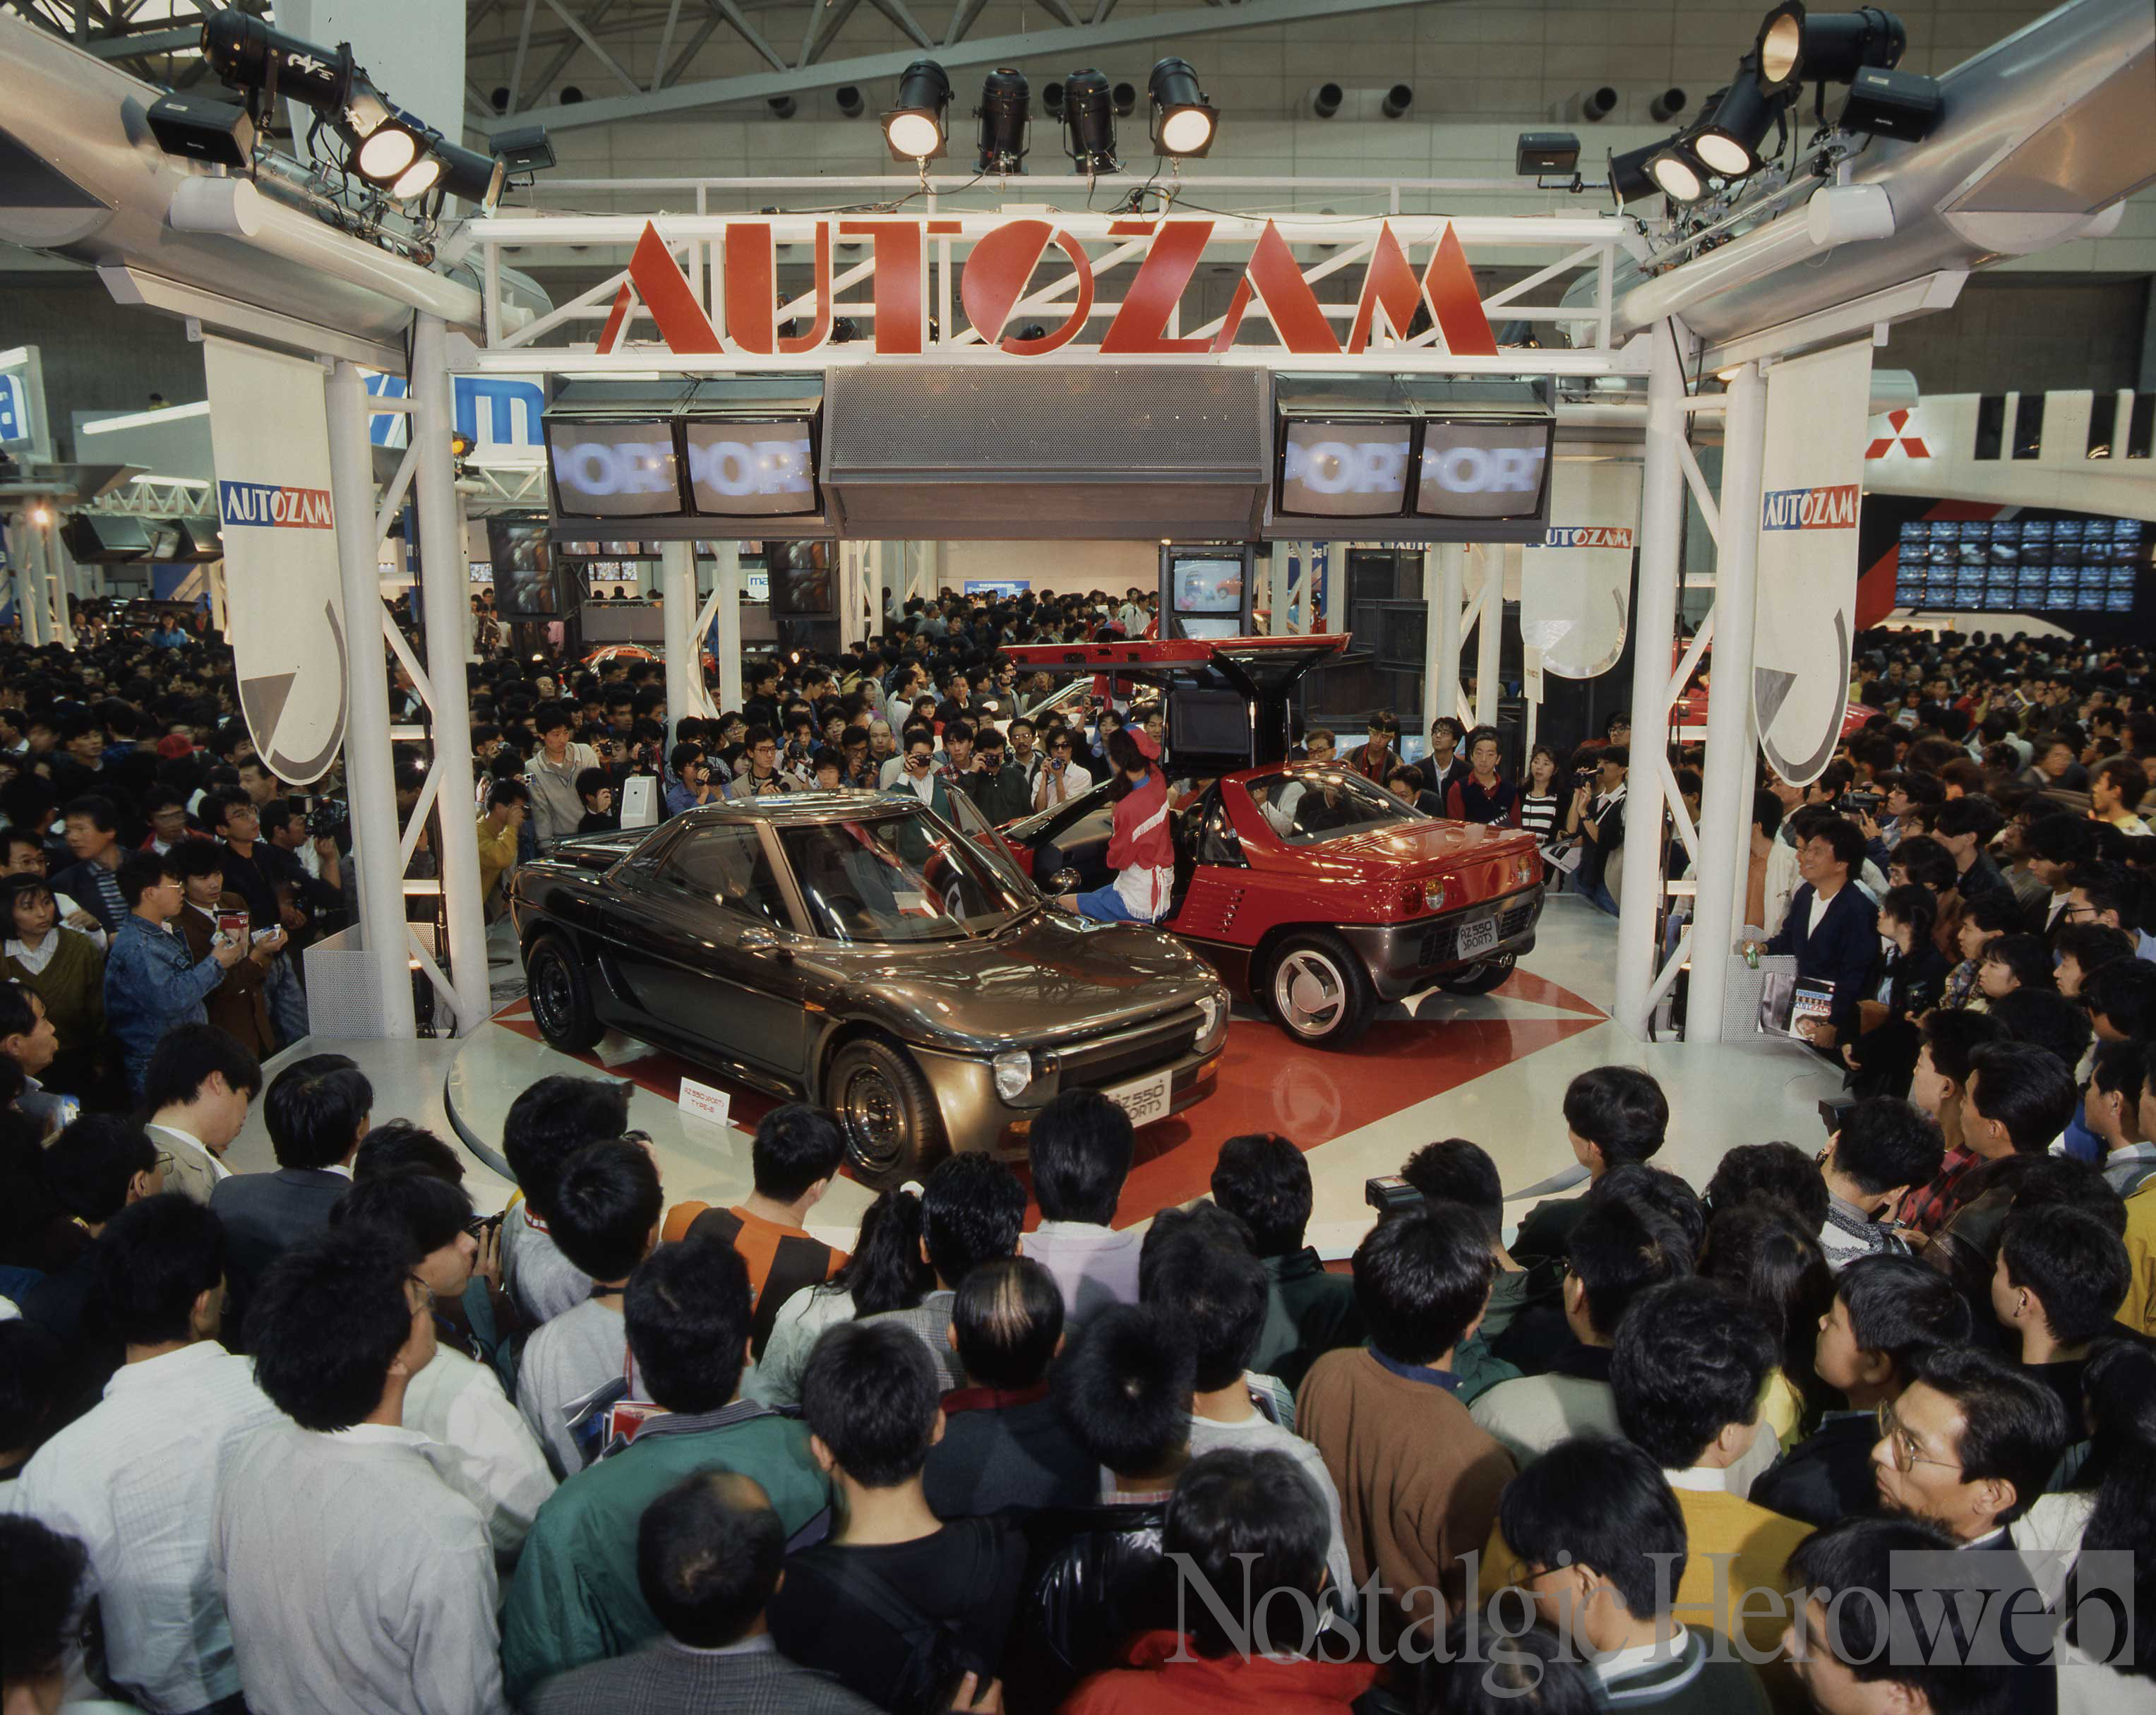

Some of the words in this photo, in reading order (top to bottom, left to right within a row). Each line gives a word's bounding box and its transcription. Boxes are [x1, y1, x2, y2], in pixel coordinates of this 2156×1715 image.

[596, 217, 1500, 356] AUTOZAM
[227, 486, 332, 525] AUTOZAM
[1764, 490, 1855, 526] AUTOZAM
[1540, 529, 1629, 548] UTOZAM
[1460, 921, 1492, 940] AZ550
[1463, 933, 1492, 951] SPORTS
[1116, 1084, 1163, 1109] Z550
[1129, 1099, 1161, 1120] ORTS
